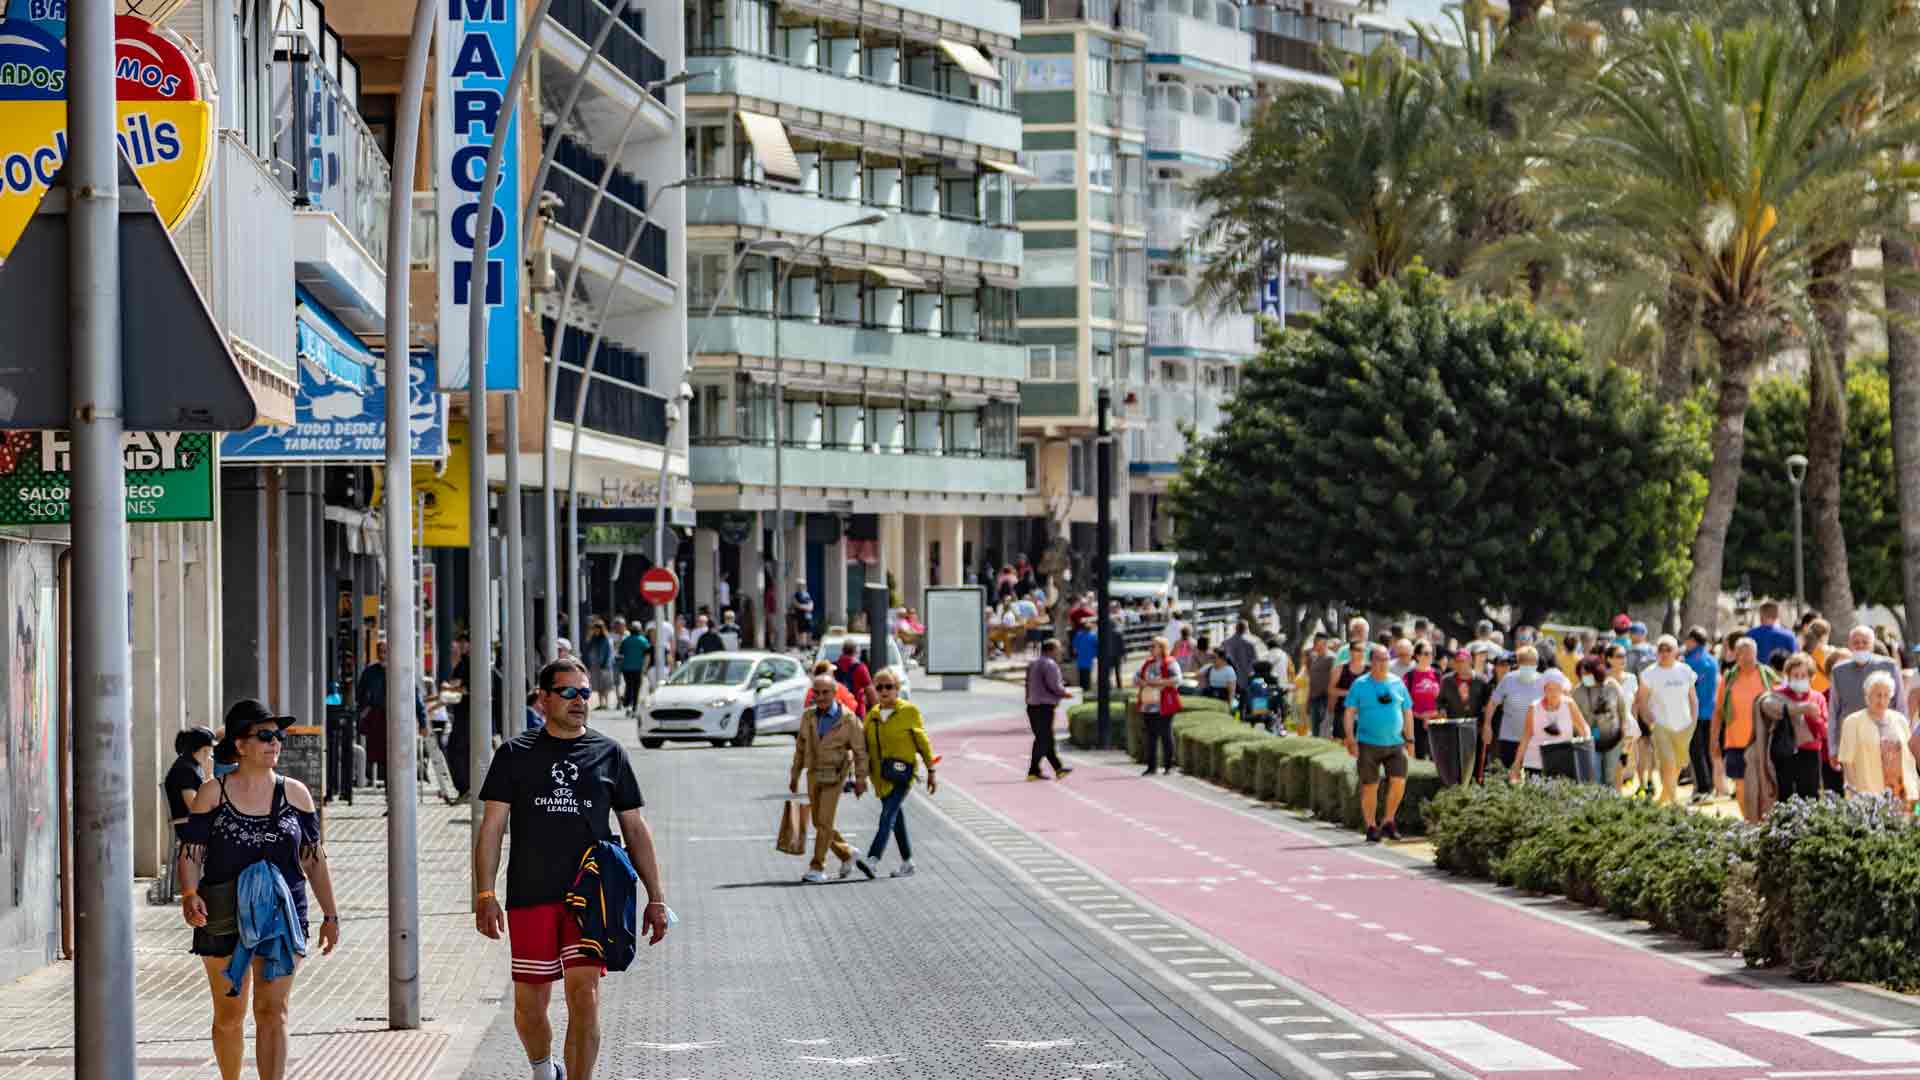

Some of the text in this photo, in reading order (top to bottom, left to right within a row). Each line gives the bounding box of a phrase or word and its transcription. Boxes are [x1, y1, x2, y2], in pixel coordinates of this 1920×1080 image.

[30, 0, 66, 20] BA
[1, 62, 66, 91] ADOS
[116, 58, 181, 96] MOS
[449, 0, 505, 306] MARCON
[297, 423, 330, 434] TODO
[334, 423, 376, 434] DESDE
[285, 437, 341, 450] TABACOS
[125, 485, 165, 499] EGO
[29, 501, 156, 515] SLOT NES
[547, 805, 579, 814] LEAGUE
